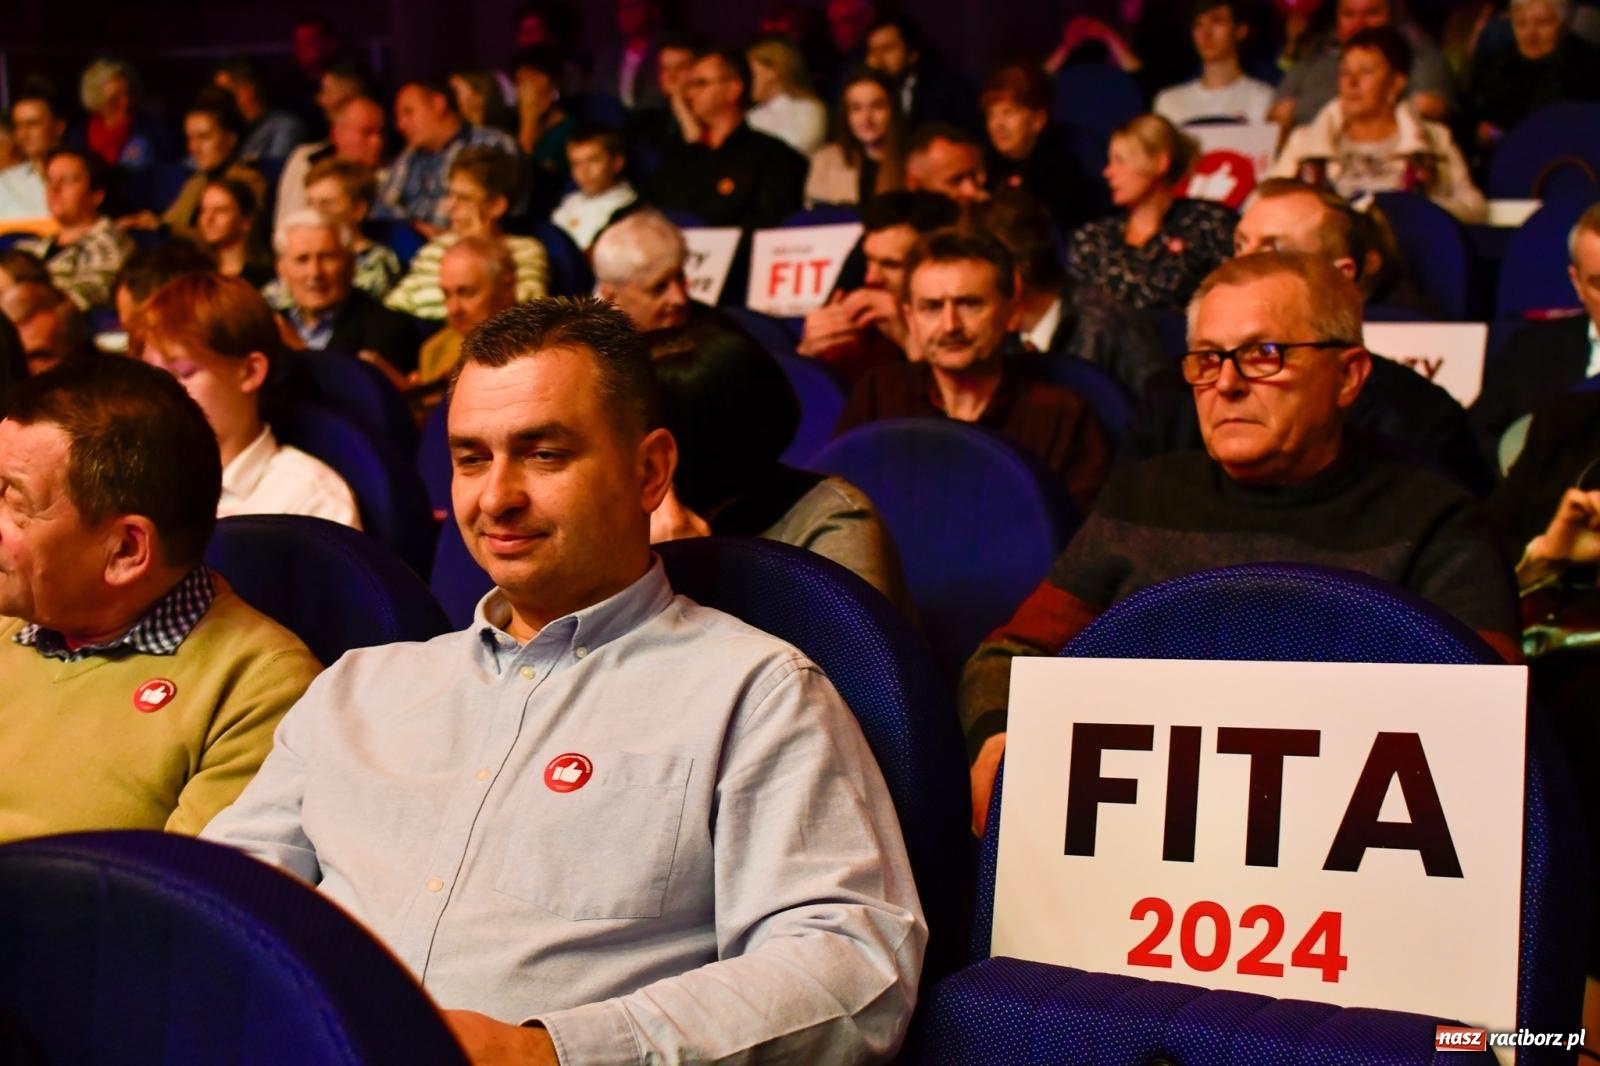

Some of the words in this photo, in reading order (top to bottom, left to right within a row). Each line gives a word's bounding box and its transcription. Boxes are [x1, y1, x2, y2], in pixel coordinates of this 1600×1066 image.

[767, 258, 832, 298] FIT
[1063, 722, 1465, 878] FITA
[1126, 896, 1348, 983] 2024
